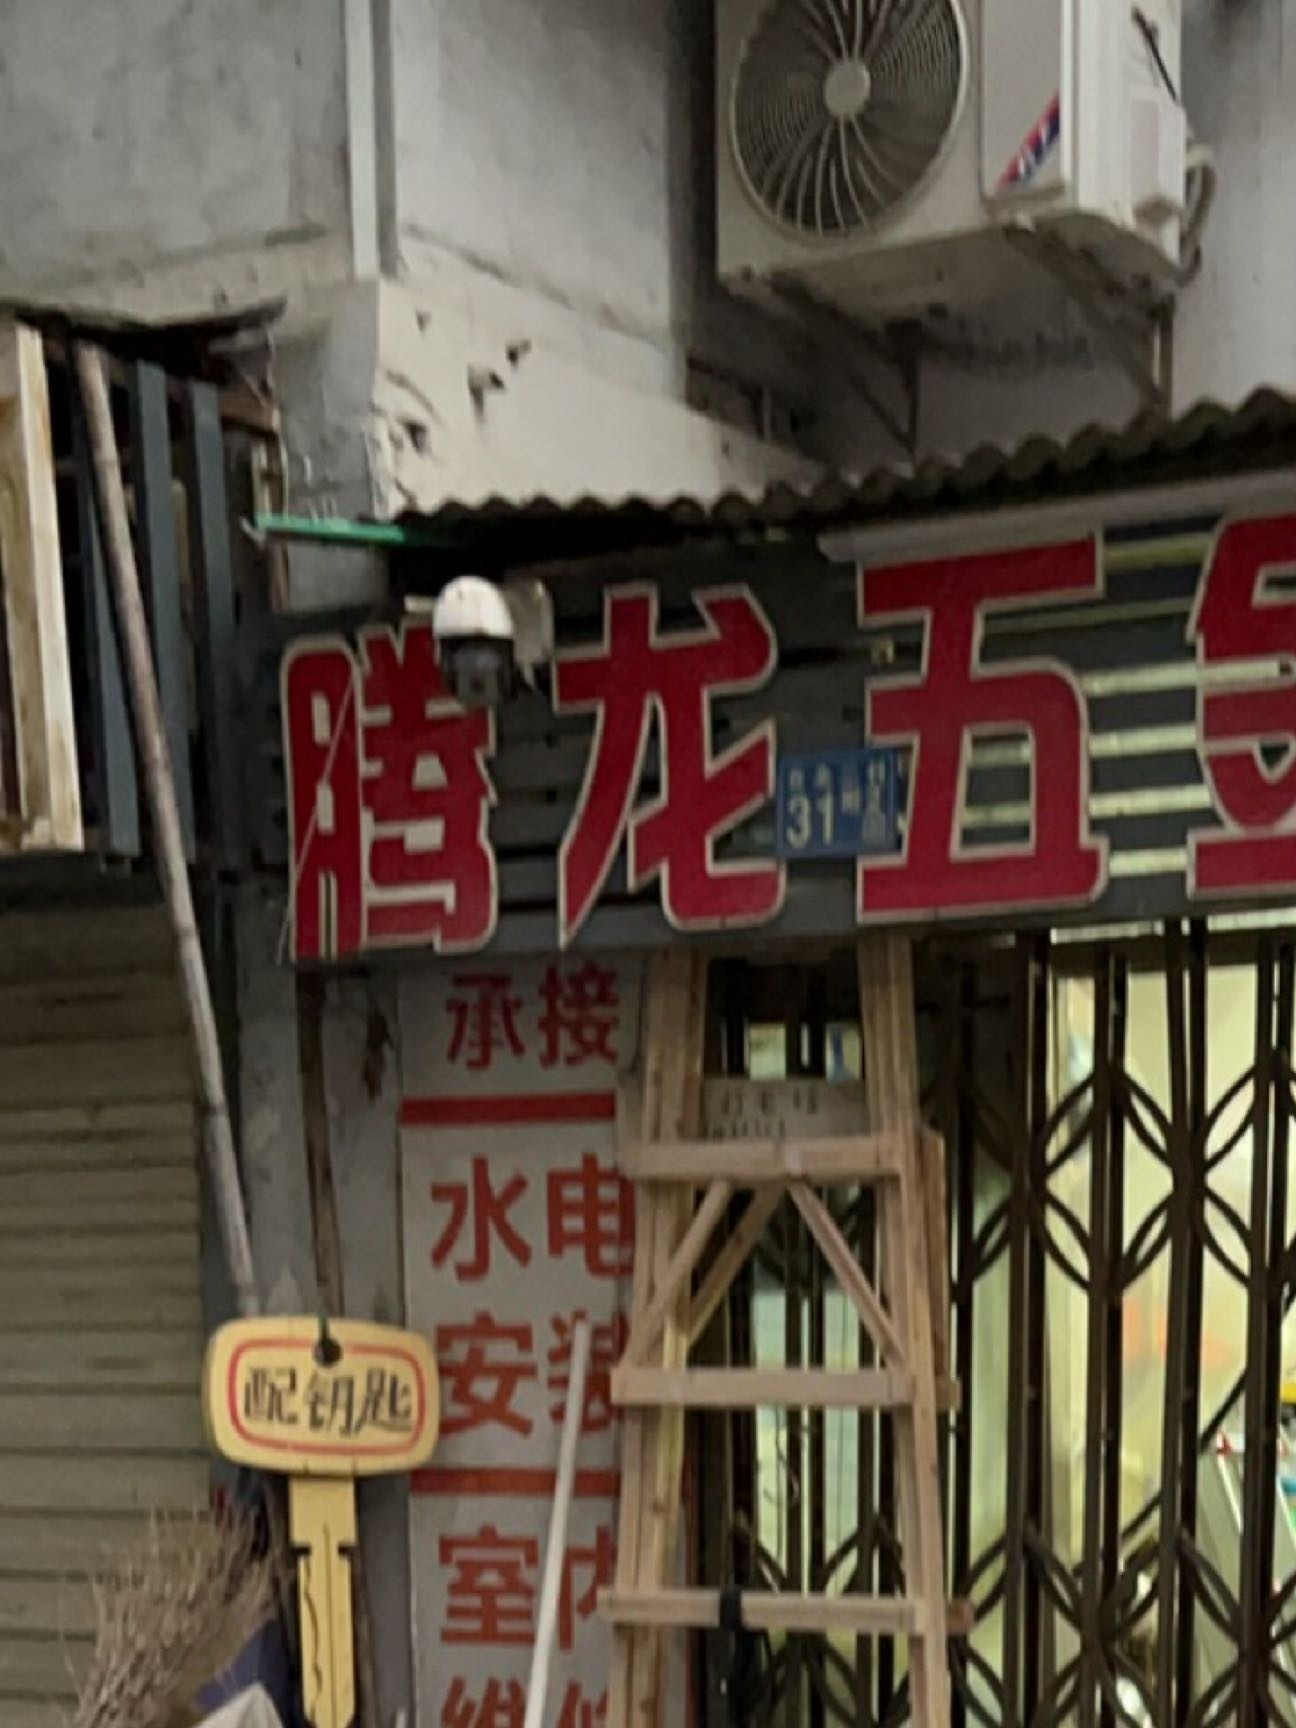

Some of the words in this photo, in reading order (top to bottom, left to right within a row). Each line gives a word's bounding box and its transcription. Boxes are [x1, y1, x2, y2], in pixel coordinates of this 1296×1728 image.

[445, 962, 620, 1070] 承接
[429, 1152, 636, 1282] 水电
[244, 1364, 412, 1437] 配钥匙
